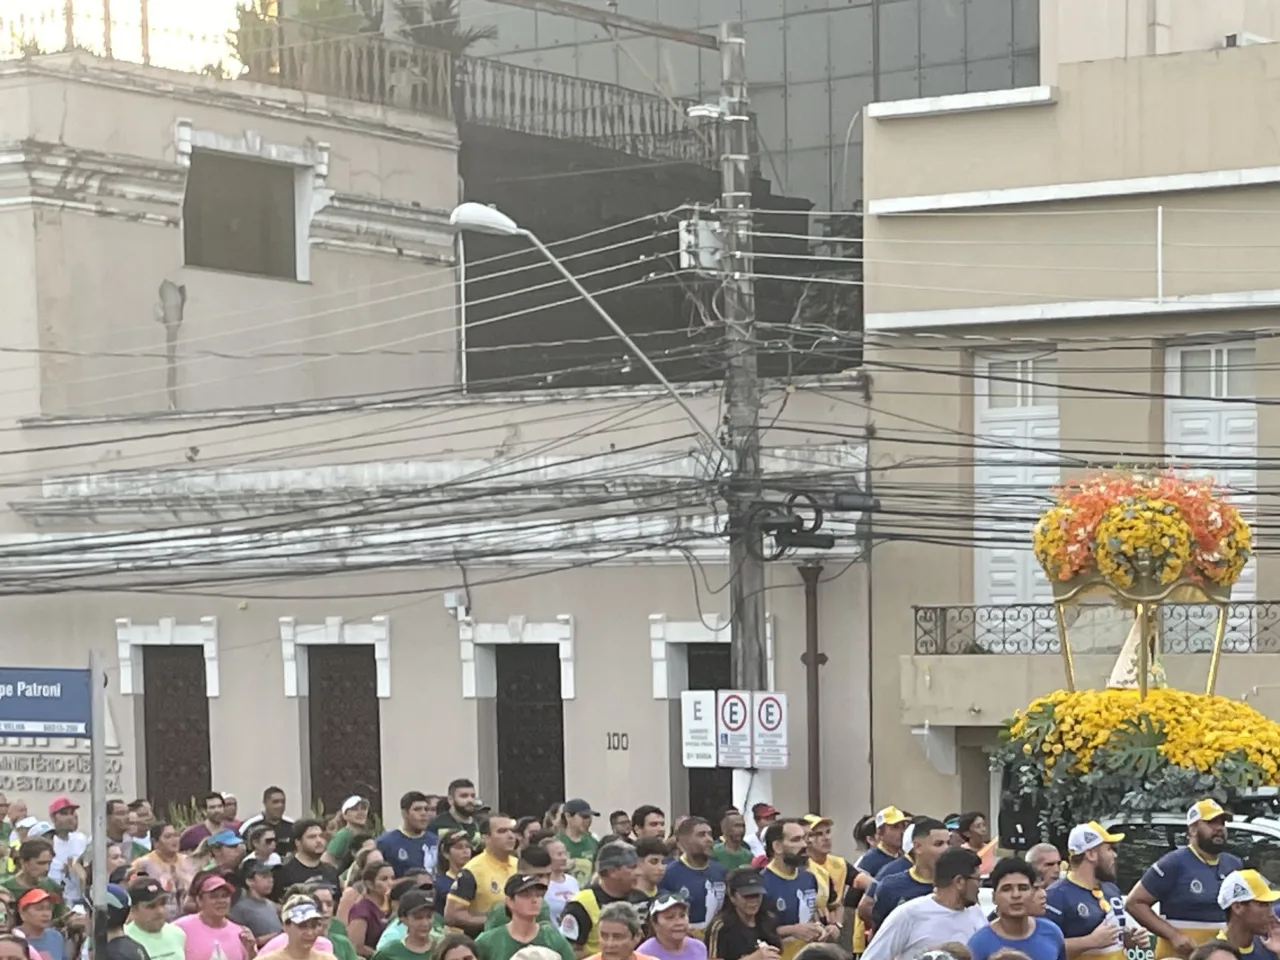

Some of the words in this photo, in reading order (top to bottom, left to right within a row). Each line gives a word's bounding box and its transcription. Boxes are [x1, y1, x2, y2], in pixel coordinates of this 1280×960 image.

[17, 681, 61, 697] Patroni
[694, 702, 703, 721] E
[730, 702, 739, 724] E
[765, 704, 775, 724] E
[607, 732, 629, 750] 100
[16, 776, 65, 792] ESTADO
